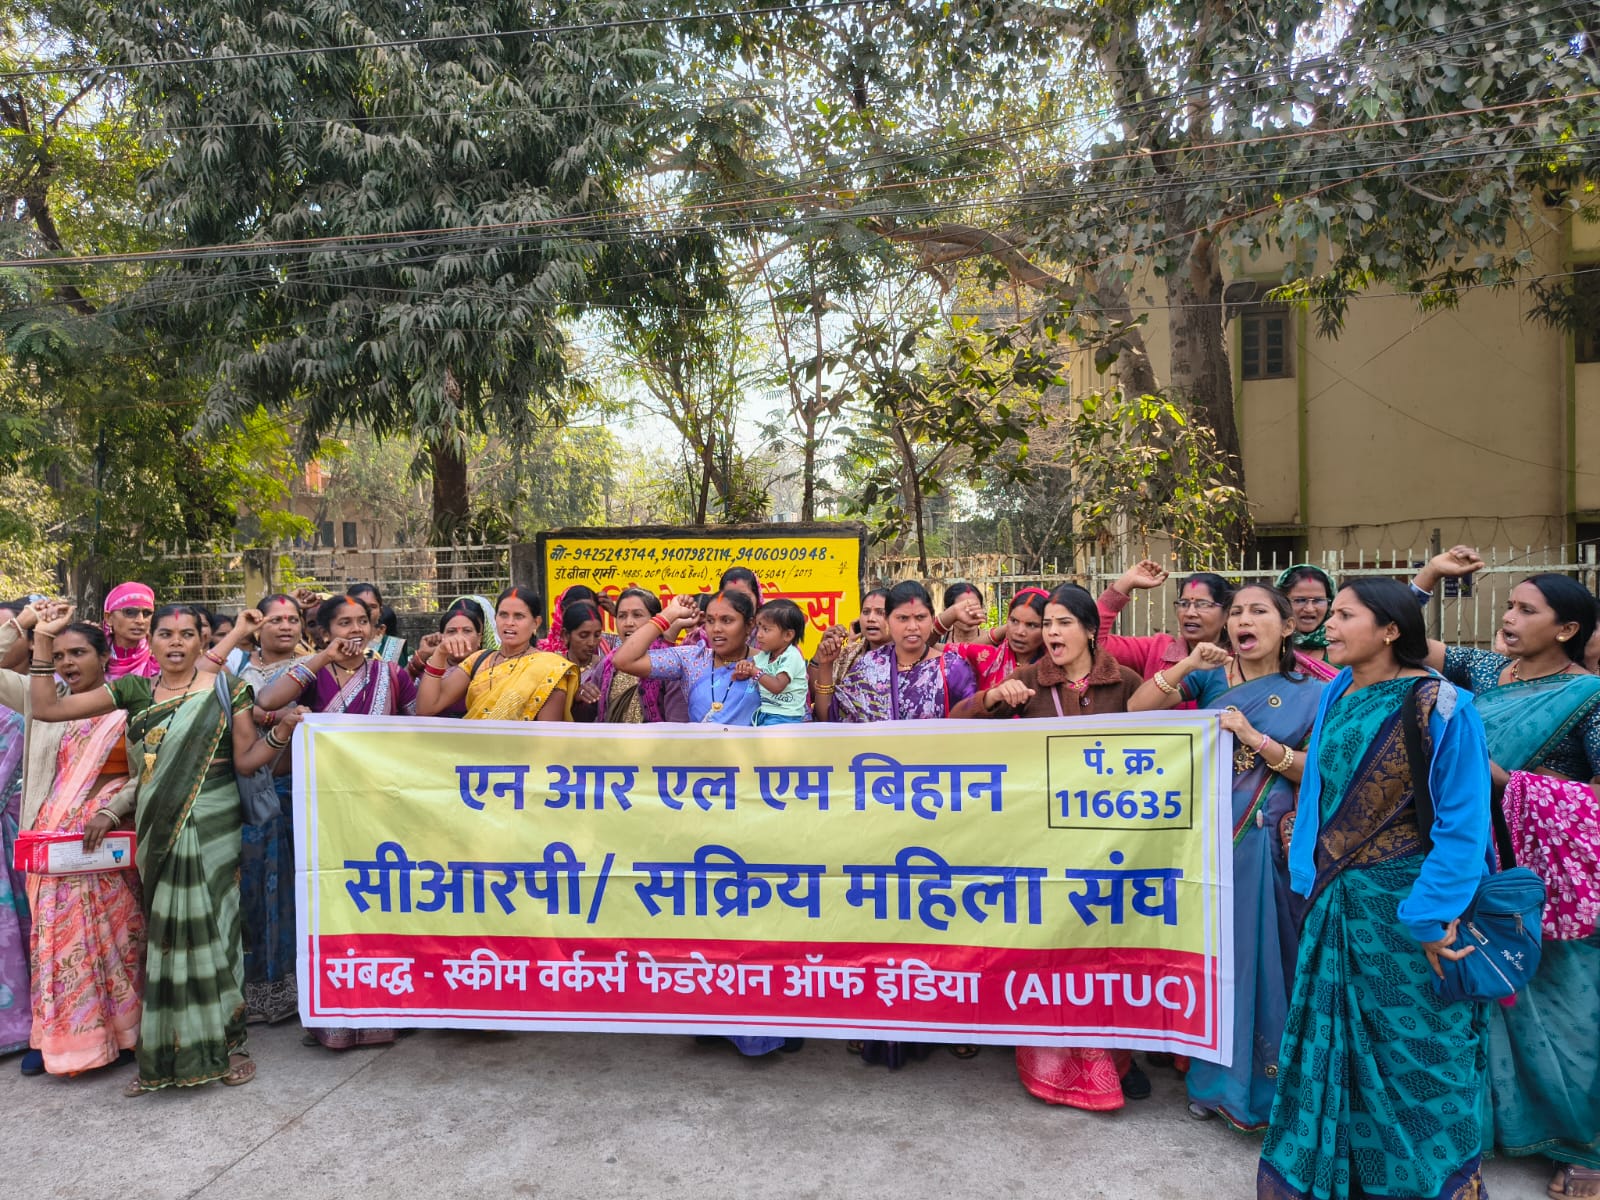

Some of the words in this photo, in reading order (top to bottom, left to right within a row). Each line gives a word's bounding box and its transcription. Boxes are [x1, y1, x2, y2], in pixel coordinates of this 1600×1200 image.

[456, 766, 529, 810] एन
[545, 766, 638, 810] आर
[653, 767, 739, 810] एल
[755, 766, 833, 810] एम
[849, 753, 1007, 820] बिहान
[1084, 742, 1113, 774] पं.
[1123, 749, 1163, 774] क्र.
[1056, 791, 1181, 819] 116635
[633, 845, 826, 918] सक्रिय
[843, 847, 1047, 930] महिला
[1066, 851, 1183, 925] संघ
[326, 949, 414, 994] संबद्ध
[443, 949, 529, 990] स्कीम
[538, 951, 628, 992] वर्कर्स
[637, 951, 773, 995] फेडरेशन
[784, 955, 865, 997] ऑफ
[875, 958, 980, 1006] इंडिया
[1005, 971, 1195, 1018] (AIUTUC)
